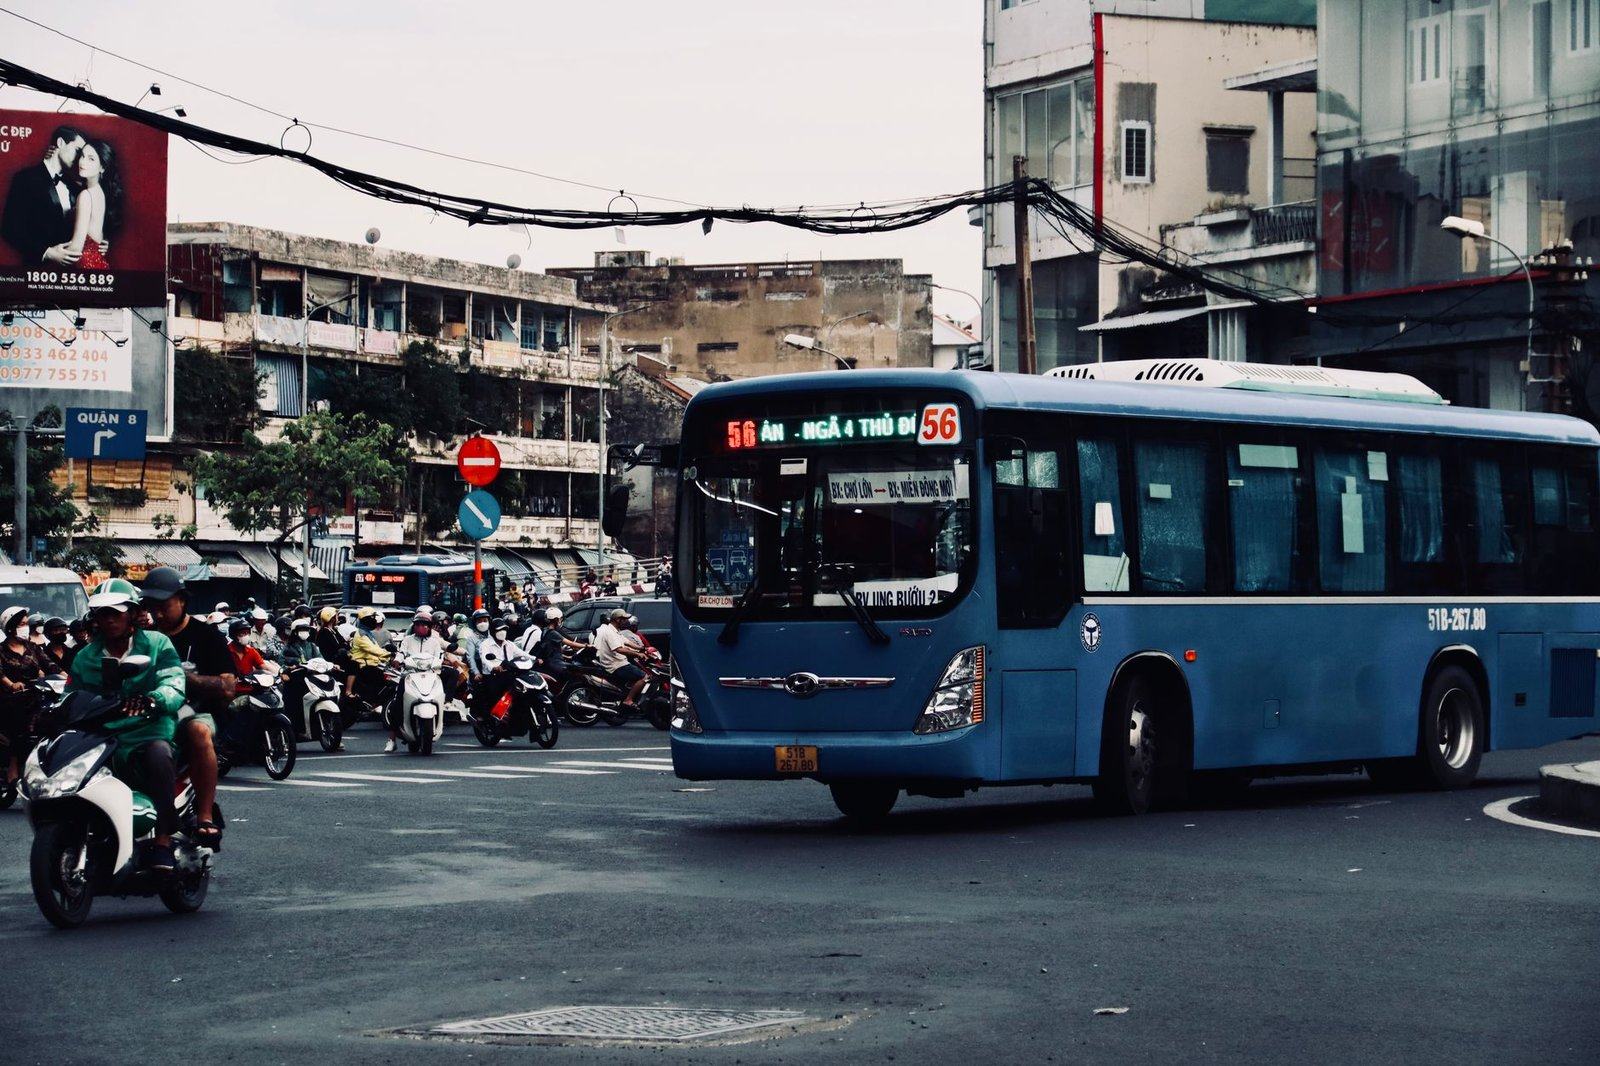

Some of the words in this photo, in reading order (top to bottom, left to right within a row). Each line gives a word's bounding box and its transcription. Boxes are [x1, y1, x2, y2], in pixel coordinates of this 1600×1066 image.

[0, 126, 8, 136] C
[10, 126, 32, 140] ĐẸP
[27, 271, 57, 283] 1800
[60, 272, 86, 284] 556
[89, 274, 114, 285] 889
[33, 309, 44, 318] CÁO
[1, 326, 42, 339] 0908
[48, 327, 77, 340] 328
[1, 348, 42, 360] 0933
[48, 349, 77, 360] 462
[82, 350, 108, 362] 404
[1, 367, 42, 379] 0977
[48, 368, 77, 380] 755
[82, 369, 107, 382] 751
[78, 411, 119, 427] QUẬN
[128, 414, 137, 424] 8
[922, 408, 956, 440] 56
[728, 420, 756, 448] 56
[844, 420, 853, 438] 4
[858, 412, 893, 437] THỦ
[832, 482, 843, 498] BX:
[844, 480, 858, 502] CHỢ
[860, 478, 873, 498] LỚN
[888, 481, 900, 498] BX:
[901, 474, 919, 498] MIỀN
[919, 476, 939, 497] ĐÔNG
[939, 475, 954, 496] MỚI
[928, 589, 936, 604] 2
[1428, 608, 1486, 630] 51B-267.80
[786, 748, 805, 758] 51B
